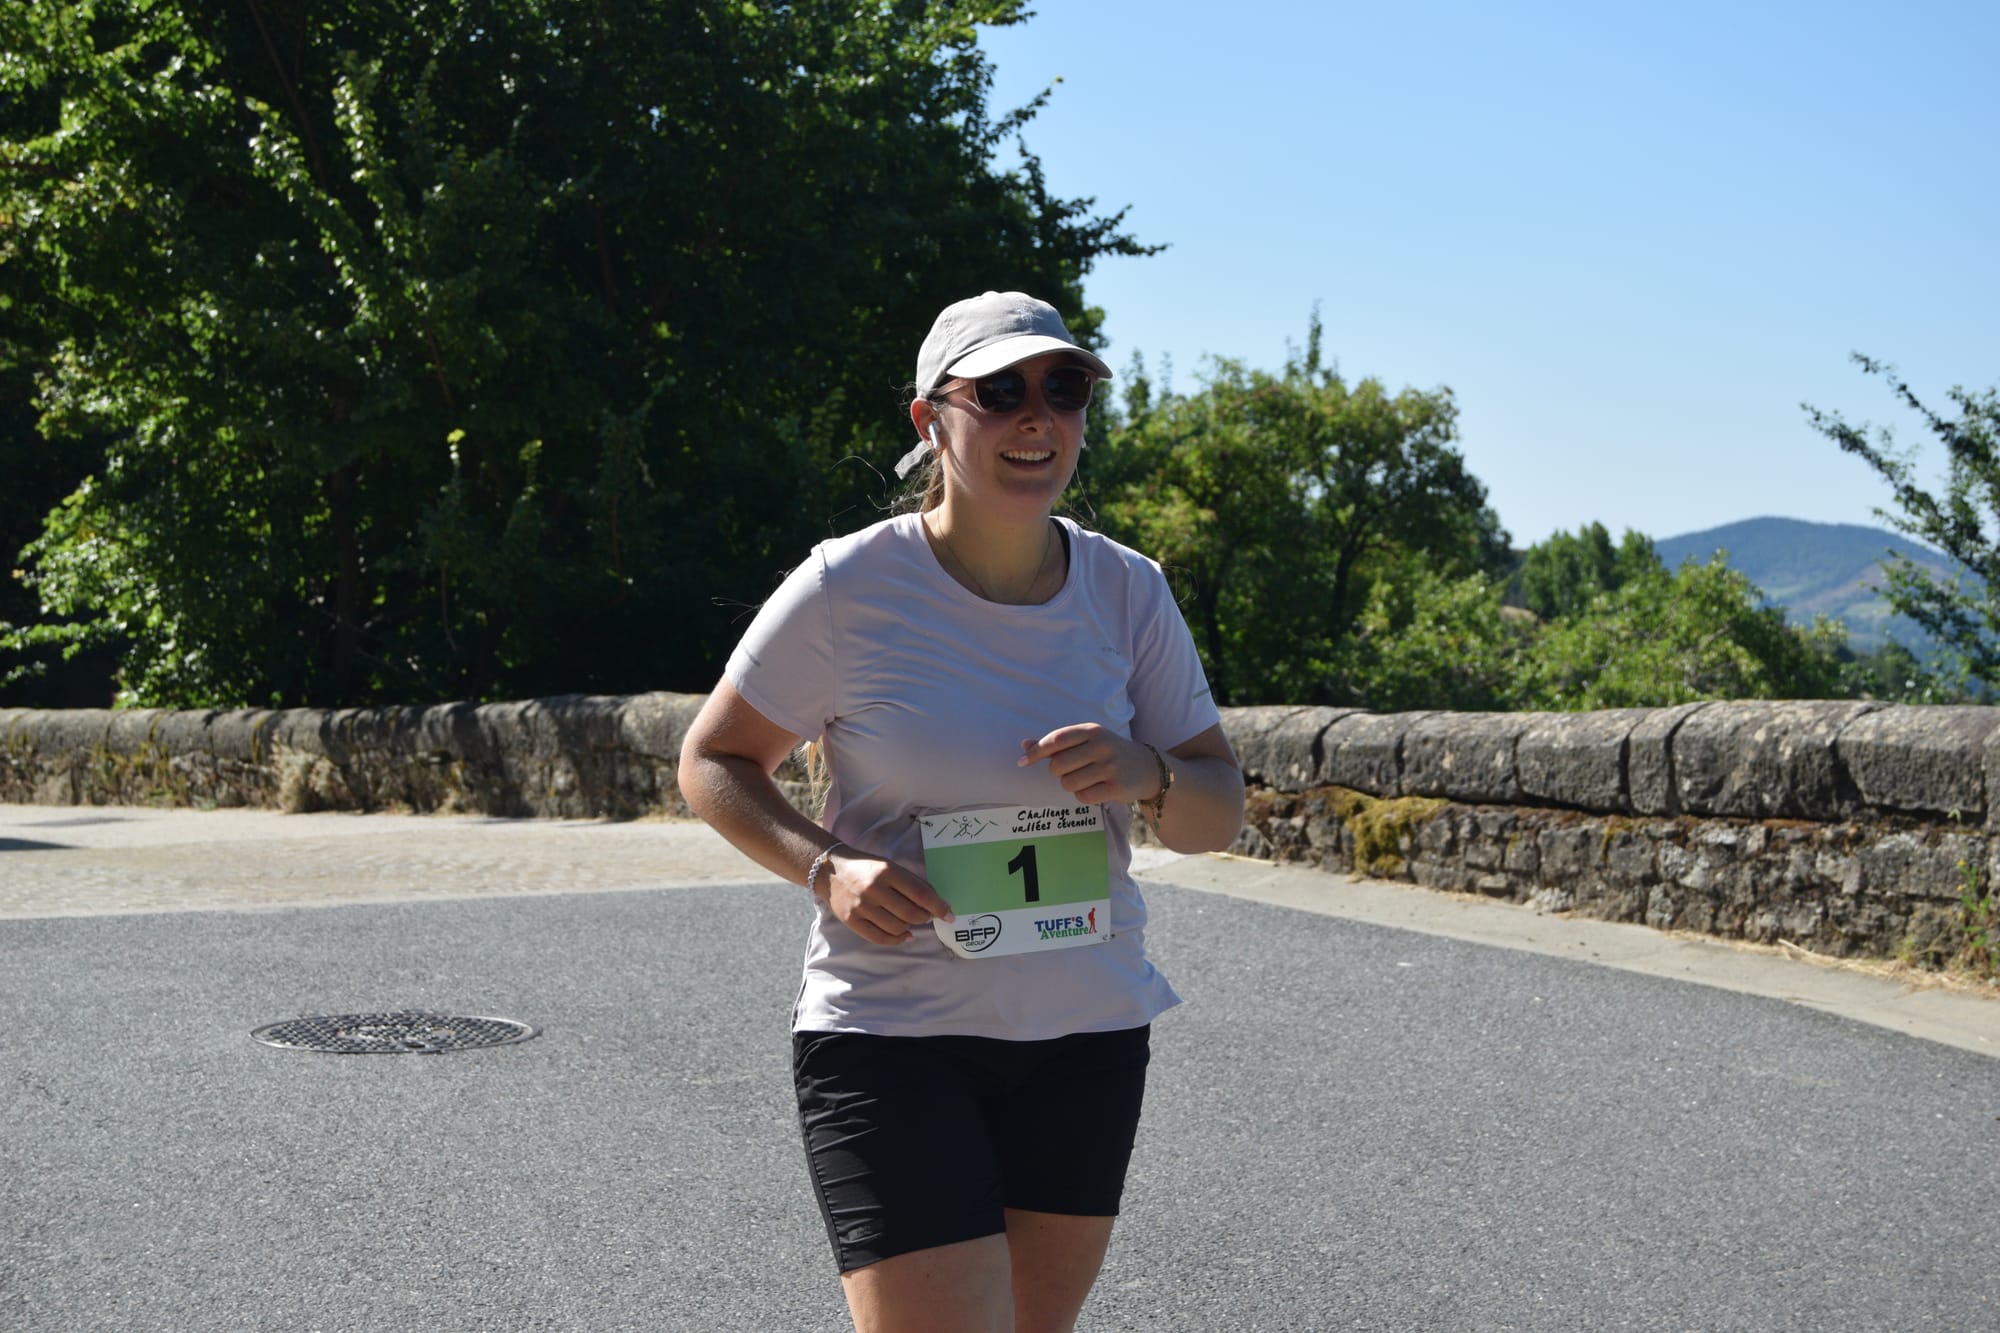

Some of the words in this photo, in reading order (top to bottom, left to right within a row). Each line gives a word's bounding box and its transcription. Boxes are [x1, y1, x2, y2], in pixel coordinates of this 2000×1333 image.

[1017, 807, 1070, 821] Challenge
[1012, 820, 1052, 833] vallées
[1007, 844, 1040, 903] 1
[1034, 915, 1084, 932] TUFF'S
[954, 926, 996, 942] BFP
[1040, 926, 1089, 940] Aventure
[965, 939, 986, 947] GROUP
